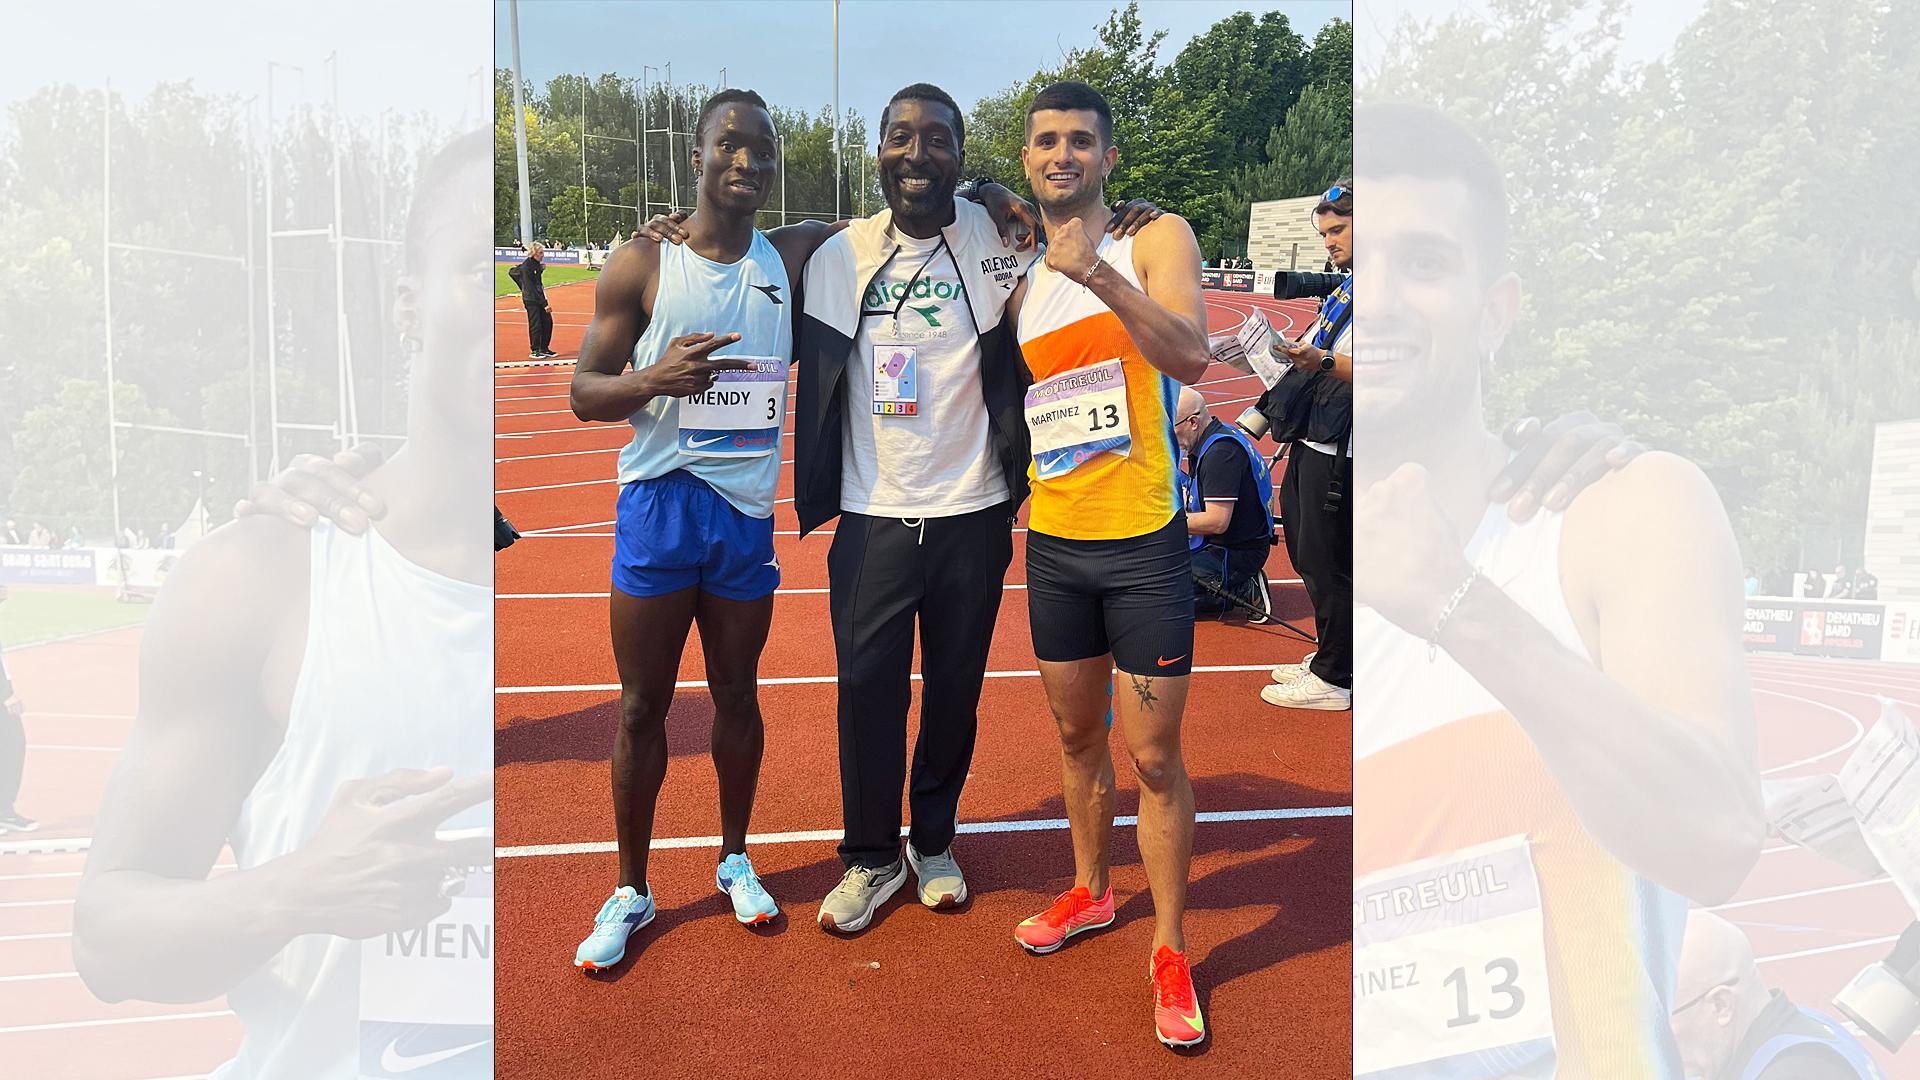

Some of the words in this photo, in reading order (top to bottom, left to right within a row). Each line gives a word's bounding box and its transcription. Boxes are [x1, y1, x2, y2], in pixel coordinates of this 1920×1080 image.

[865, 276, 963, 308] diador
[928, 331, 947, 339] 1948
[1032, 368, 1113, 399] MONTREUIL
[688, 391, 750, 405] MENDY
[766, 397, 776, 420] 3
[877, 404, 881, 412] 1
[887, 404, 892, 412] 2
[898, 404, 903, 412] 3
[1031, 406, 1080, 427] MARTINEZ
[1087, 404, 1120, 432] 13
[1744, 608, 1793, 622] EMATHIEU
[1353, 864, 1509, 930] NTREUIL
[385, 923, 490, 960] MEN
[1442, 957, 1526, 1028] 13
